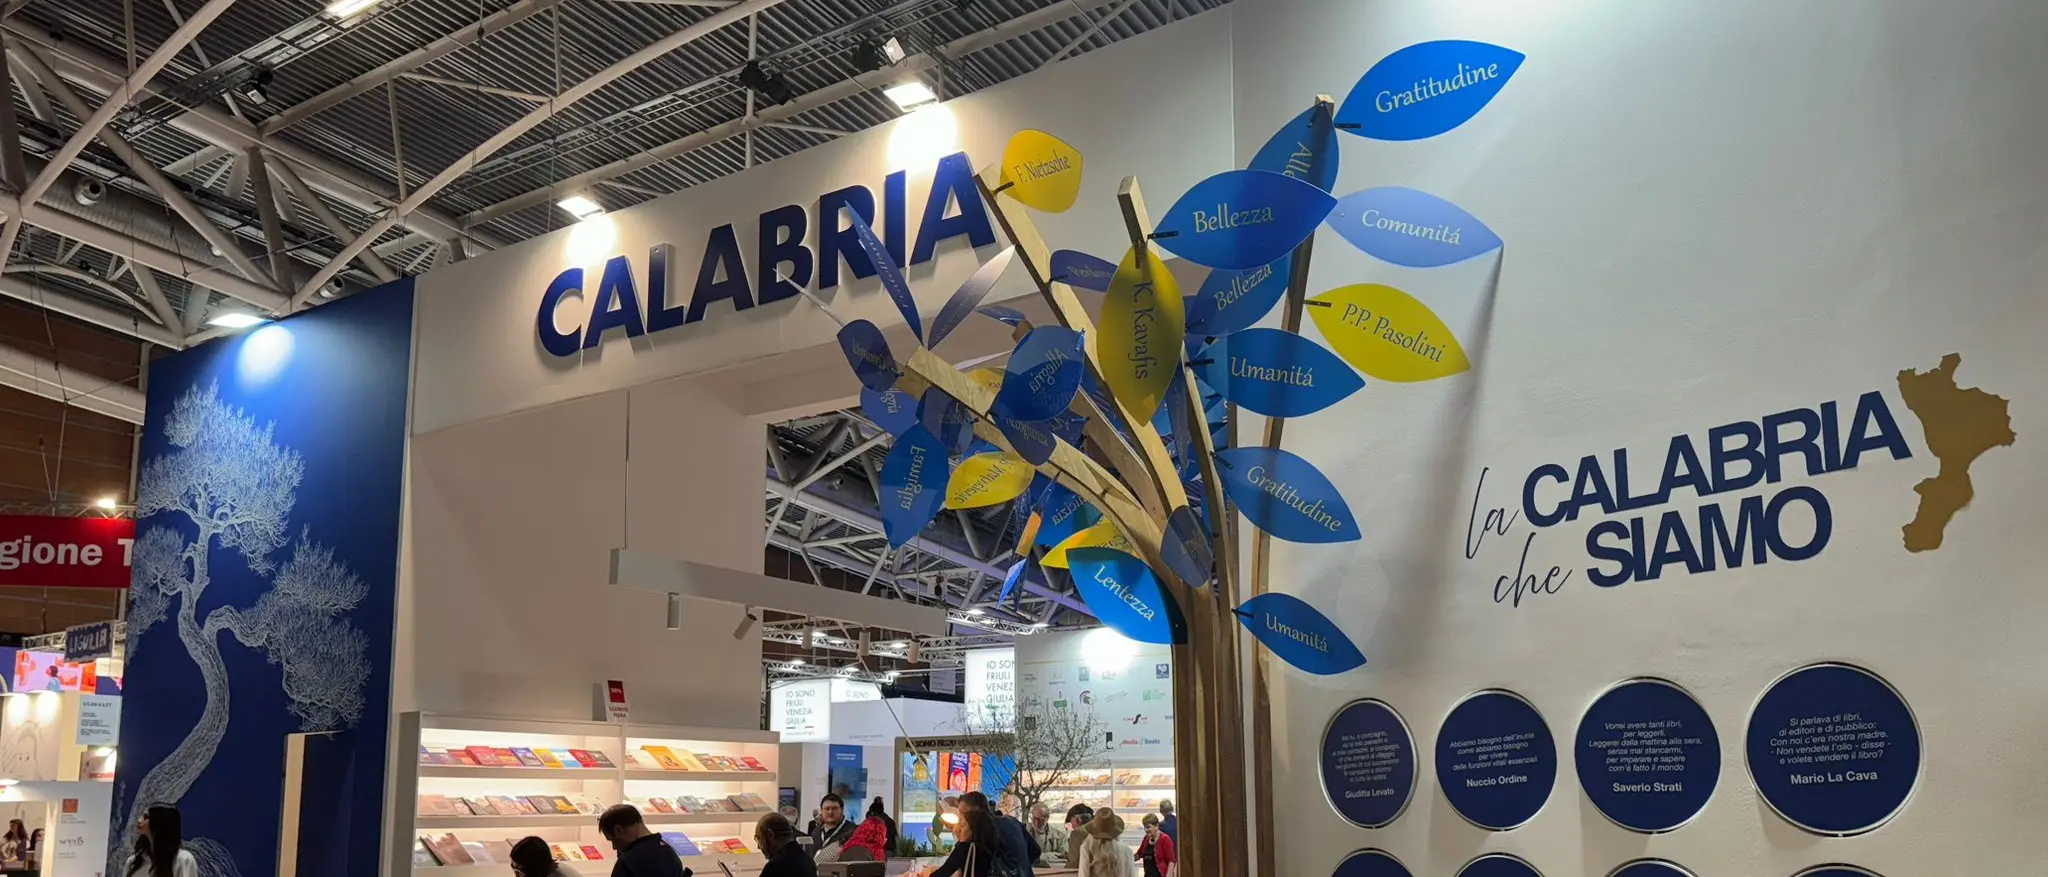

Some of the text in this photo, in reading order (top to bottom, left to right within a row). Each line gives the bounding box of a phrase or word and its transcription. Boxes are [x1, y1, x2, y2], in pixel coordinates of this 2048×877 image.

[1375, 62, 1498, 114] Gratitudine
[1282, 141, 1312, 177] Alle
[1014, 149, 1071, 184] F. Nietzsche
[1193, 202, 1274, 233] Bellezza
[1362, 209, 1461, 246] Comunitá
[538, 151, 997, 357] CALABRIA
[1214, 263, 1272, 311] Bellezza
[1128, 280, 1157, 380] K. Kavafis
[1342, 303, 1447, 363] P.P. Pasolini
[1230, 357, 1314, 388] Umanitá
[1465, 390, 1913, 560] la CALABRIA
[1247, 465, 1342, 532] Gratitudine
[0, 535, 103, 570] gione
[1493, 486, 1833, 607] che SIAMO
[1094, 564, 1155, 621] Lentezza
[1264, 612, 1329, 653] Umanitá
[986, 660, 997, 669] IO
[986, 672, 1011, 681] FRIULI
[795, 689, 815, 698] SONO
[986, 682, 1014, 692] VENEZ
[1790, 718, 1798, 726] Si
[1800, 716, 1830, 726] parlava
[1832, 714, 1841, 722] di
[1778, 728, 1787, 736] di
[1788, 726, 1815, 736] editori
[1825, 724, 1833, 733] di
[1835, 722, 1877, 733] pubblico:
[1450, 740, 1476, 748] Abbiamo
[1477, 736, 1502, 745] bisogno
[1475, 745, 1501, 753] abbiamo
[1503, 741, 1528, 750] bisogno
[1588, 740, 1619, 748] Leggerei
[1620, 739, 1638, 747] dalla
[1640, 738, 1667, 746] mattina
[1770, 738, 1787, 747] Con
[1789, 737, 1802, 745] noi
[1804, 735, 1826, 744] c'era
[1828, 734, 1855, 742] nostra
[1776, 747, 1794, 756] Non
[1796, 745, 1829, 754] vendete
[1831, 743, 1852, 752] l'olio
[1861, 741, 1885, 749] disse
[1620, 756, 1652, 764] imparare
[1787, 755, 1812, 764] volete
[1814, 753, 1849, 762] vendere
[1851, 751, 1856, 760] il
[1858, 750, 1883, 759] libro?
[1468, 760, 1492, 769] funzioni
[1632, 764, 1650, 772] fatto
[1466, 774, 1528, 788] Nuccio Ordine
[1790, 770, 1878, 784] Mario La Cava
[1372, 788, 1394, 797] Levato
[1613, 781, 1682, 792] Saverio Strati
